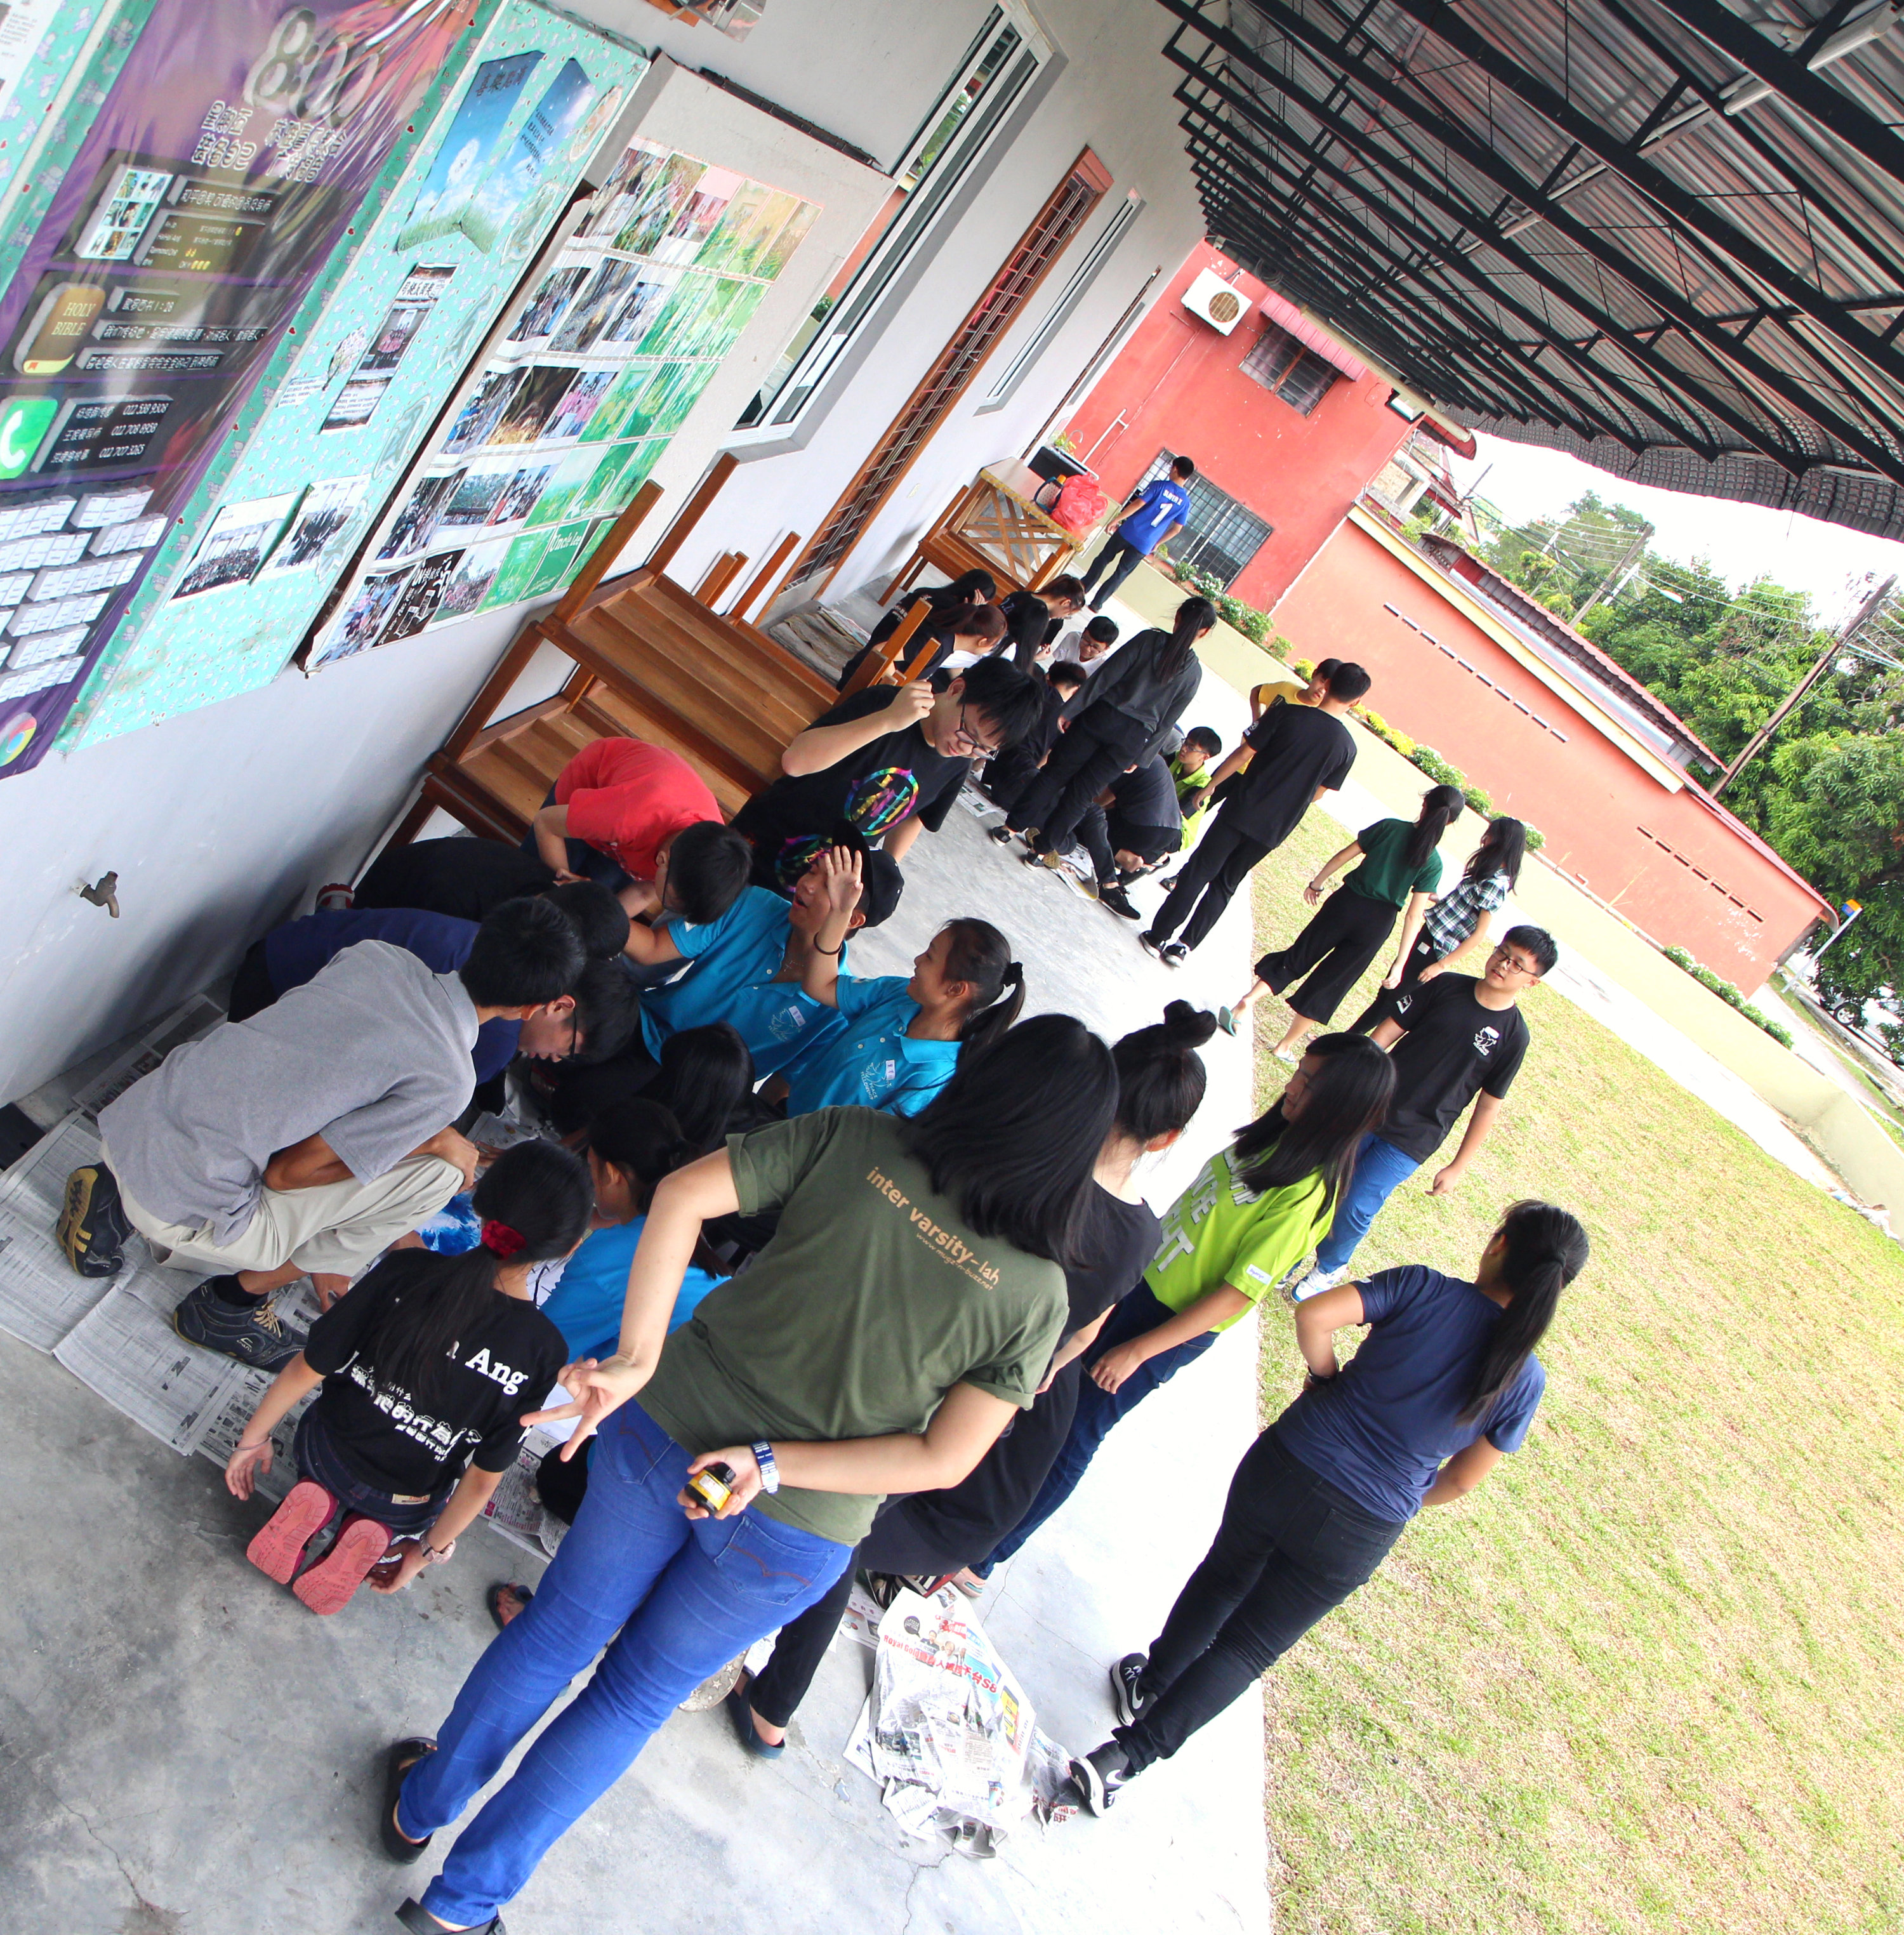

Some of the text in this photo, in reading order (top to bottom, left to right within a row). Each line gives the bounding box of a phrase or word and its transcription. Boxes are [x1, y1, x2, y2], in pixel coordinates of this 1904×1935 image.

[63, 302, 96, 317] HOLY
[51, 322, 86, 336] BIBLE
[550, 525, 572, 553] Uncle
[866, 1166, 910, 1208] inter
[465, 1347, 529, 1396] Ang
[883, 1634, 904, 1651] Royal
